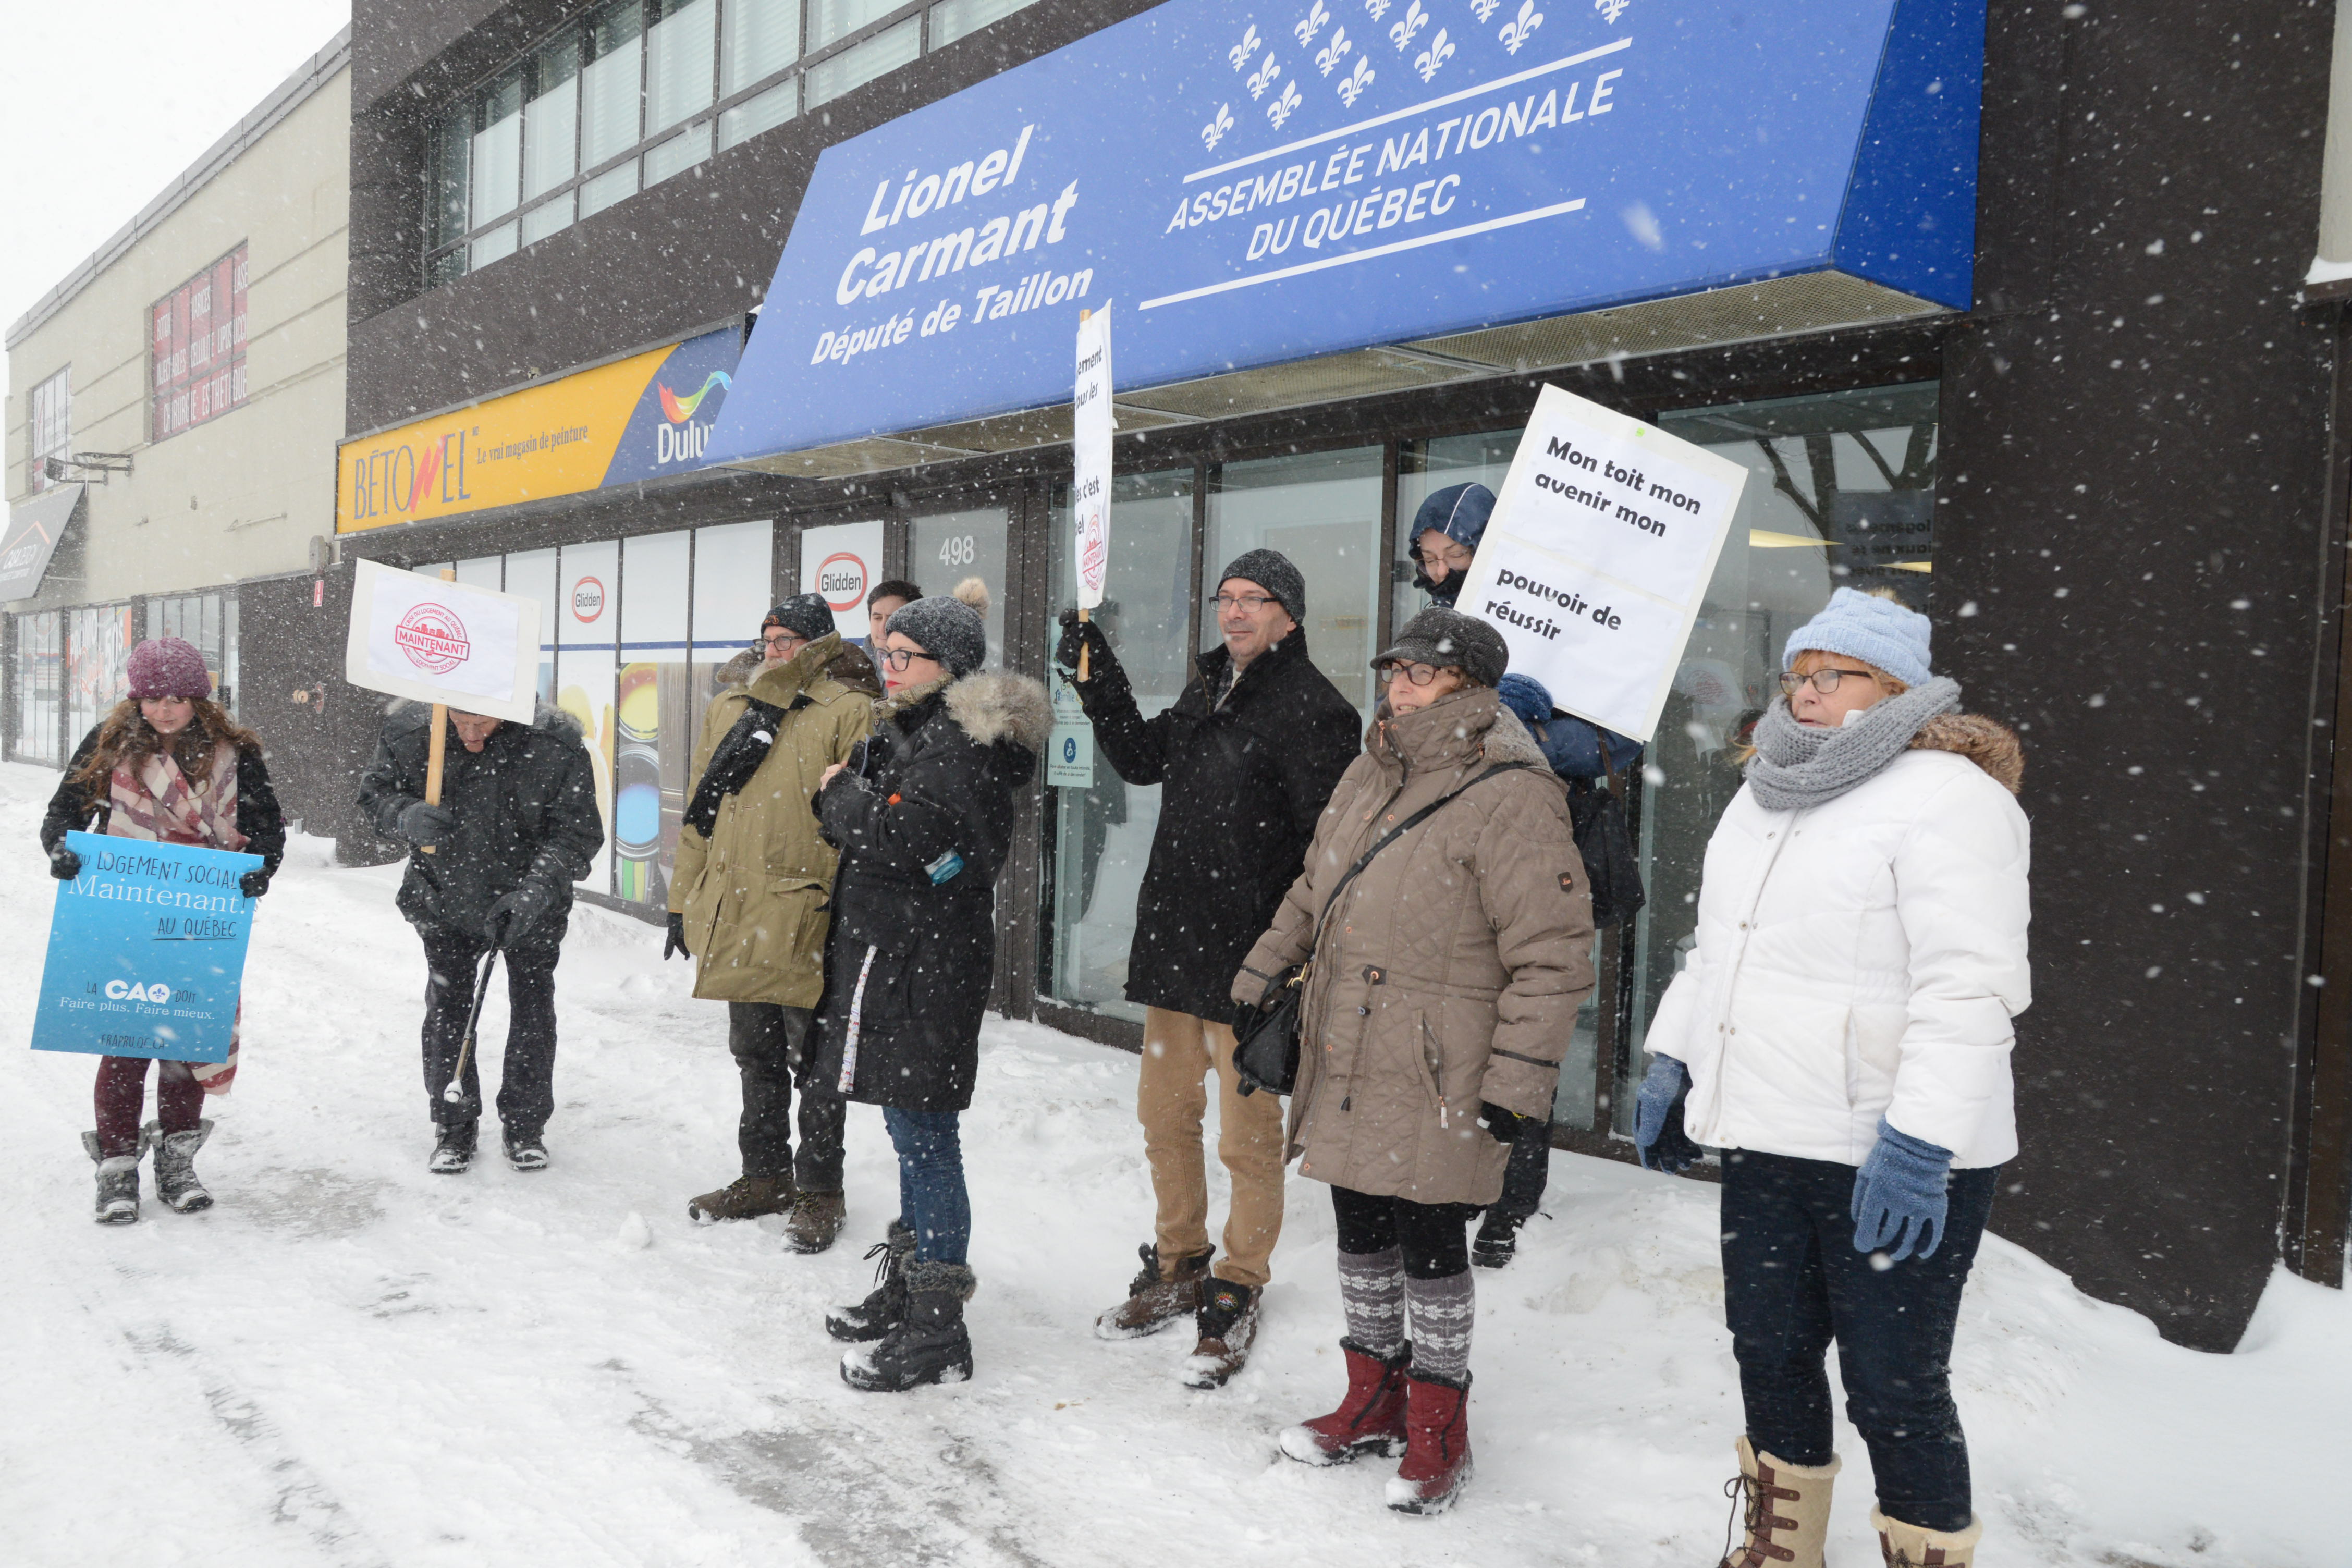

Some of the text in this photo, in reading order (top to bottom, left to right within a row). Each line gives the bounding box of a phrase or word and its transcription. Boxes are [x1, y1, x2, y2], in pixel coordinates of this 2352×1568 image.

[1166, 68, 1622, 233] ASSEMBLÉE NATIONALE
[860, 124, 1034, 236] Lionel
[1246, 174, 1460, 260] DU QUÉBEC
[836, 178, 1079, 305] Carmant
[191, 285, 211, 321] VARICES
[811, 268, 1093, 365] Député de Taillon
[164, 365, 247, 432] CHIRURGIE ESTHÉTIQUE
[1089, 382, 1098, 400] les
[477, 425, 588, 464] Le vrai magasin de peinture
[658, 420, 714, 464] Dulu
[1547, 436, 1701, 515] Mon toit mon
[1535, 471, 1667, 537] avenir mon
[939, 536, 974, 566] 498
[575, 593, 601, 607] Glidden
[821, 573, 861, 592] Glidden
[1496, 568, 1621, 630] pouvoir de
[405, 616, 415, 626] CRISE
[421, 608, 444, 617] LOGEMENT
[450, 621, 462, 639] QUÉBEC
[1485, 599, 1561, 640] réussir
[399, 631, 466, 655] MAINTENANT
[439, 659, 456, 670] SOCIAL
[97, 851, 182, 880] LOGEMENT
[185, 865, 237, 889] SOCIAL
[158, 916, 237, 937] AU QUÉBEC
[59, 997, 215, 1020] Faire plus. Faire mieux.
[87, 979, 197, 1005] LA CAQ DOIT
